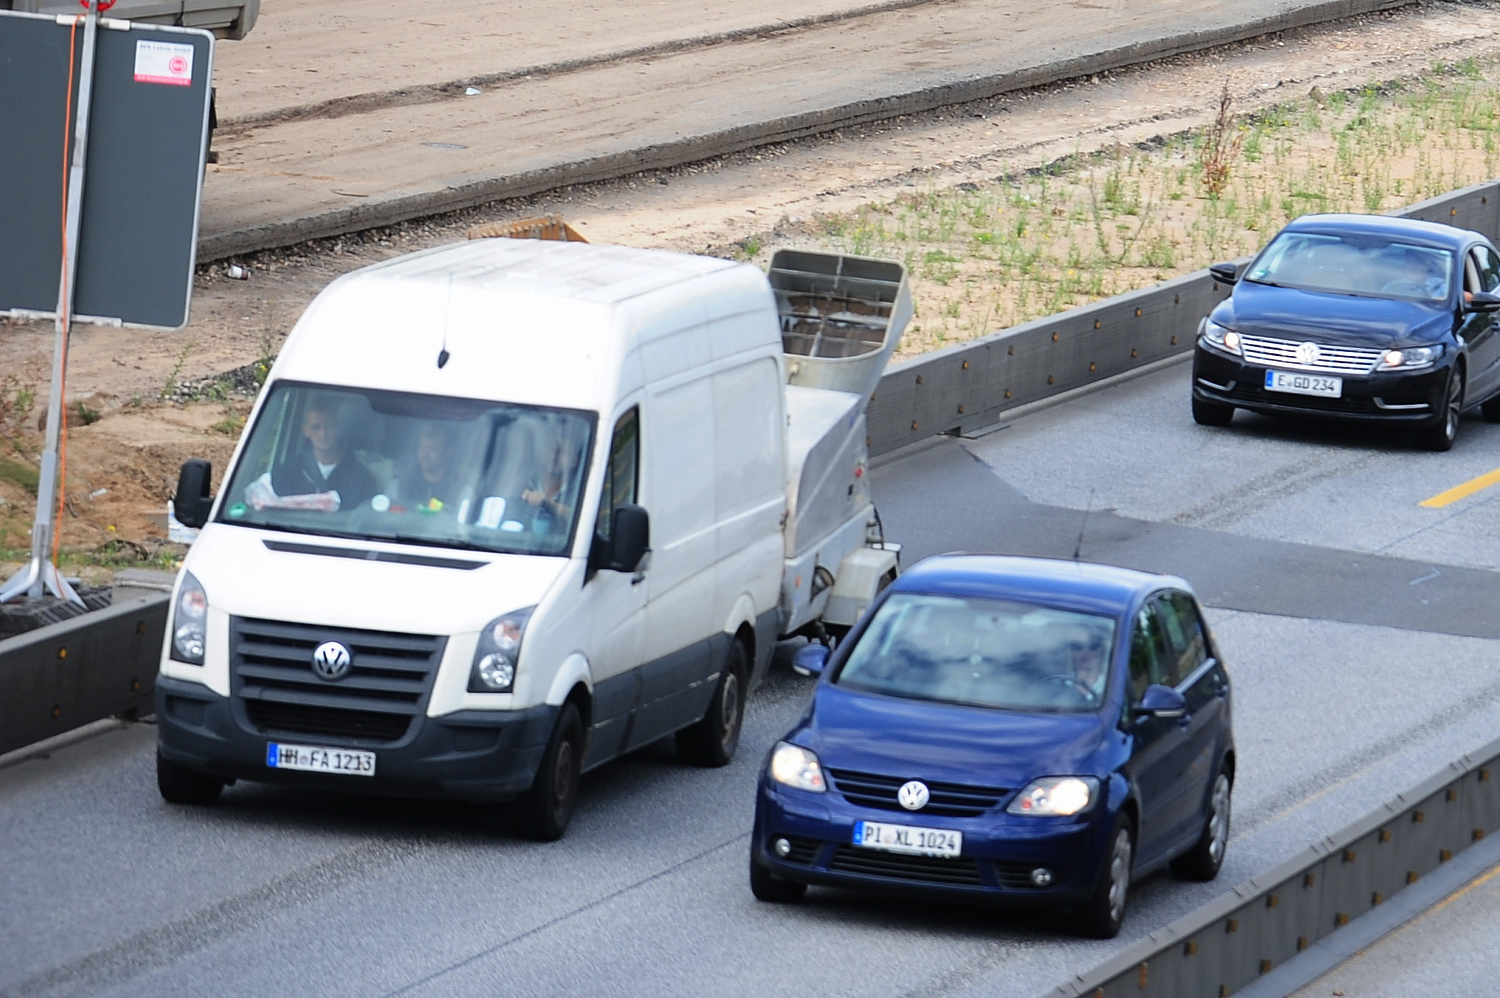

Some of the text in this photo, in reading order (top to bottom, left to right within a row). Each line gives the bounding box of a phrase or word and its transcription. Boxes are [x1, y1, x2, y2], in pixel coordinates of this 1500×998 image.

[1278, 374, 1335, 392] E GD 234
[279, 748, 372, 772] HH FA 1213
[865, 825, 956, 851] PI XL 1024
